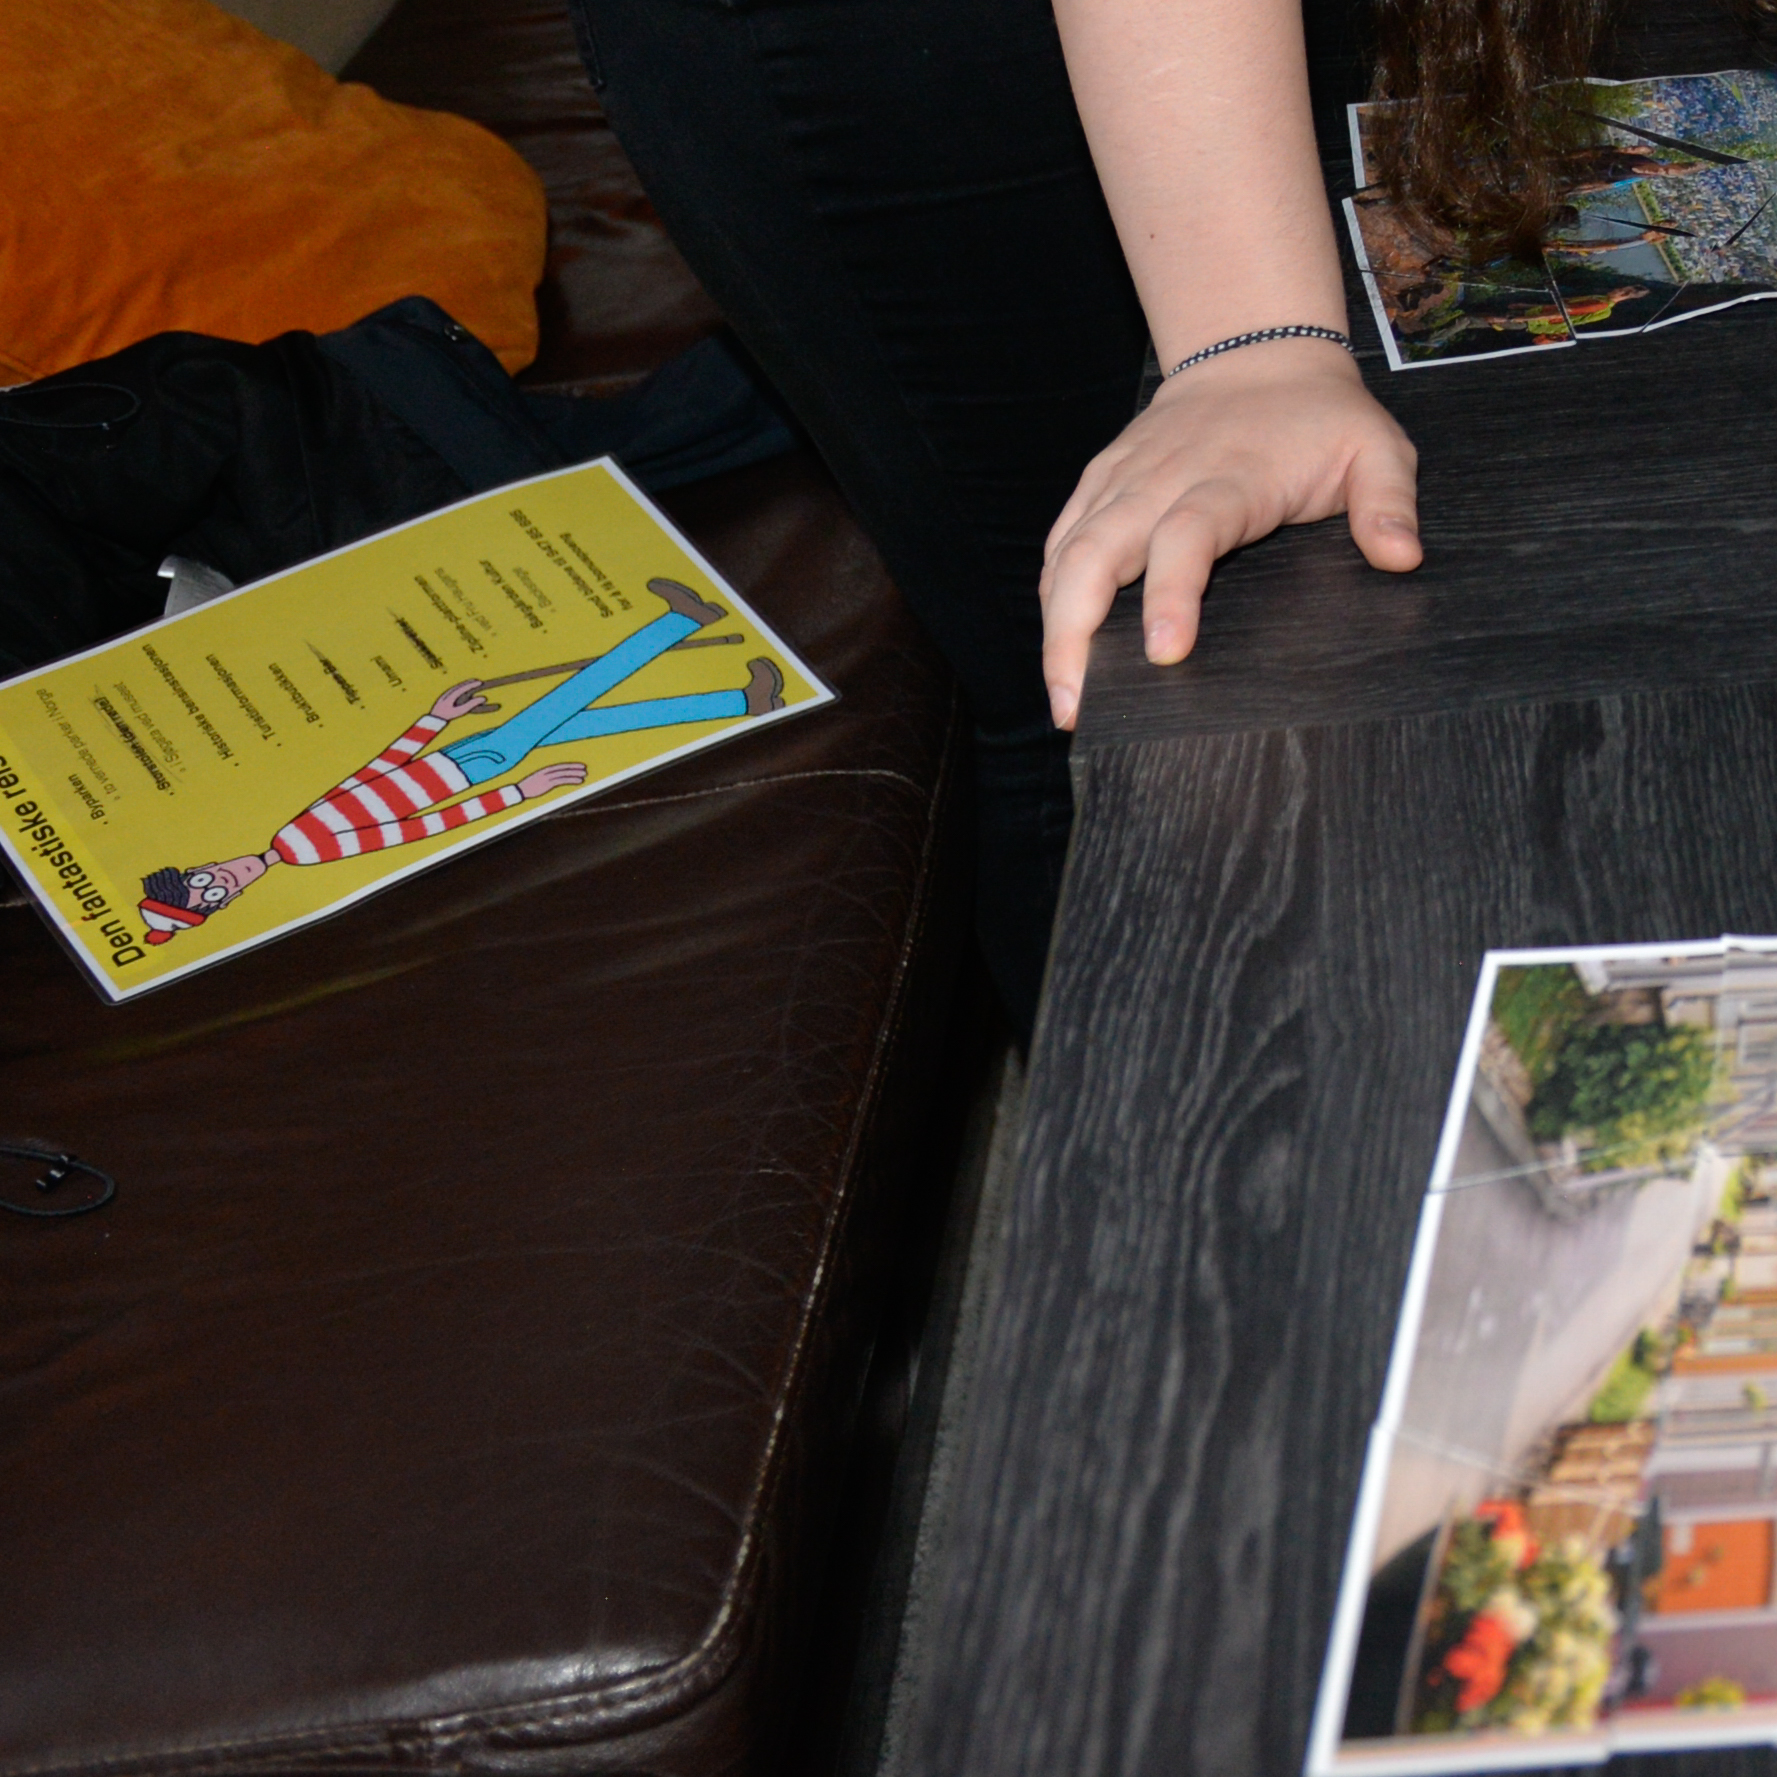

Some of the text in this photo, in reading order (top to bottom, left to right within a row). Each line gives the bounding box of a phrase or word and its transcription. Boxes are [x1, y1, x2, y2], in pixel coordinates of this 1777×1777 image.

[479, 560, 505, 585] Kultur
[414, 575, 484, 653] Zipline-plattformen
[370, 655, 403, 687] Umami
[36, 688, 61, 718] Norge
[113, 681, 142, 714] museet
[142, 644, 234, 760] Historiske bensinstasjonen
[206, 654, 274, 740] Turistinformasjonen
[268, 663, 320, 723] Bruktbutikken
[58, 721, 86, 749] parker
[134, 712, 155, 730] ved
[149, 729, 179, 763] Sjøgata
[78, 748, 109, 784] vernede
[68, 774, 105, 820] Byparken
[103, 783, 117, 795] to
[15, 801, 110, 921] fantastiske
[100, 919, 146, 967] Den
